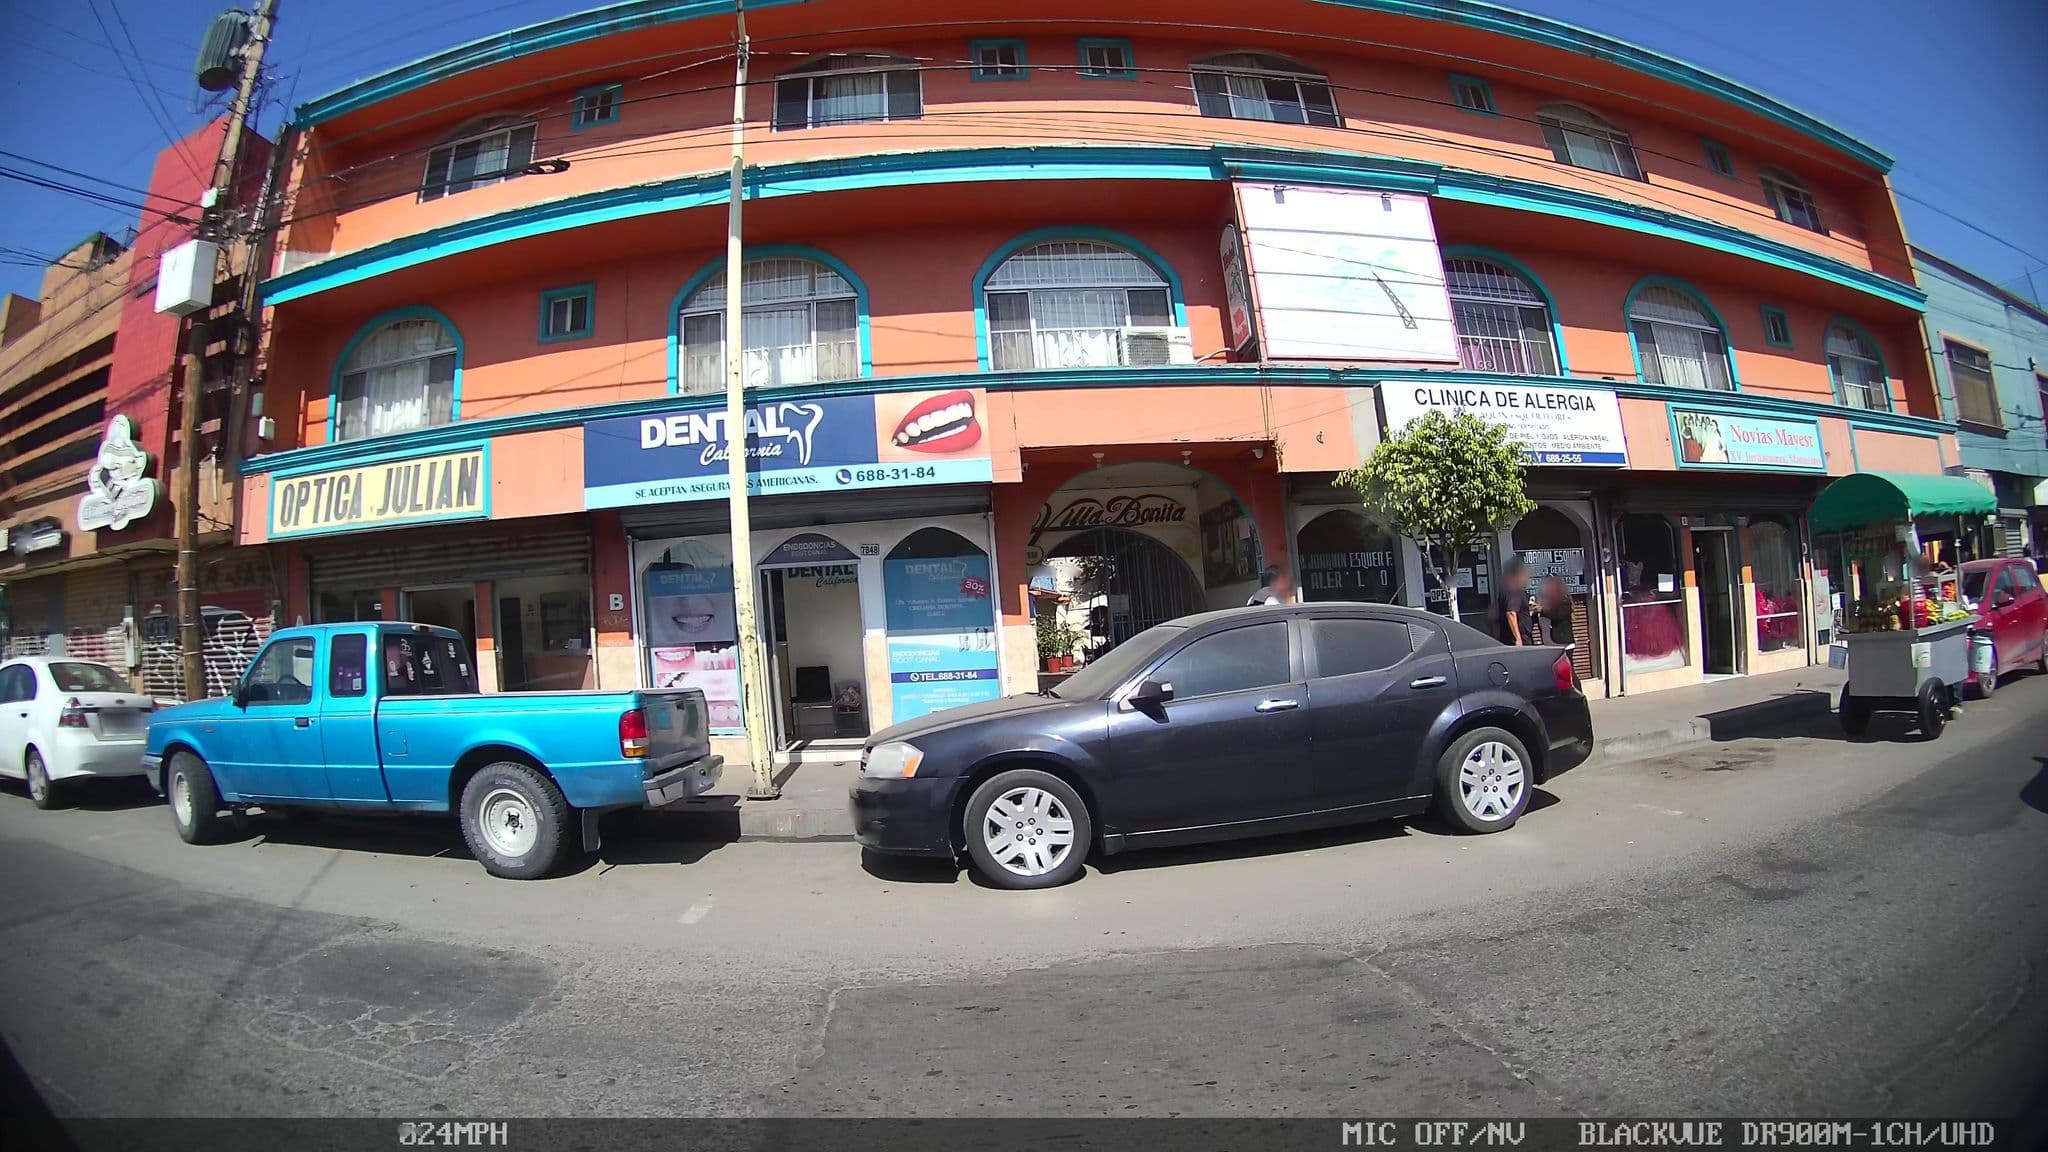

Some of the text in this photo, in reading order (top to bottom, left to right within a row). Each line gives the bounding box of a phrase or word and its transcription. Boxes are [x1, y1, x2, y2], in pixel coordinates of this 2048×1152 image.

[1414, 388, 1596, 412] CLINICA DE ALERGIA
[641, 406, 791, 450] DENTAL
[1729, 424, 1773, 444] Novias
[700, 442, 784, 466] Calornia
[635, 489, 647, 499] SE
[649, 486, 687, 497] ACEPTAN
[756, 474, 819, 488] AMERICANAS.
[855, 466, 936, 483] 688-31-84
[280, 455, 480, 528] OPTICA JULIAN
[1028, 494, 1187, 547] Villa Bonita
[783, 541, 837, 552] ENDODONCIAS
[609, 593, 624, 611] B
